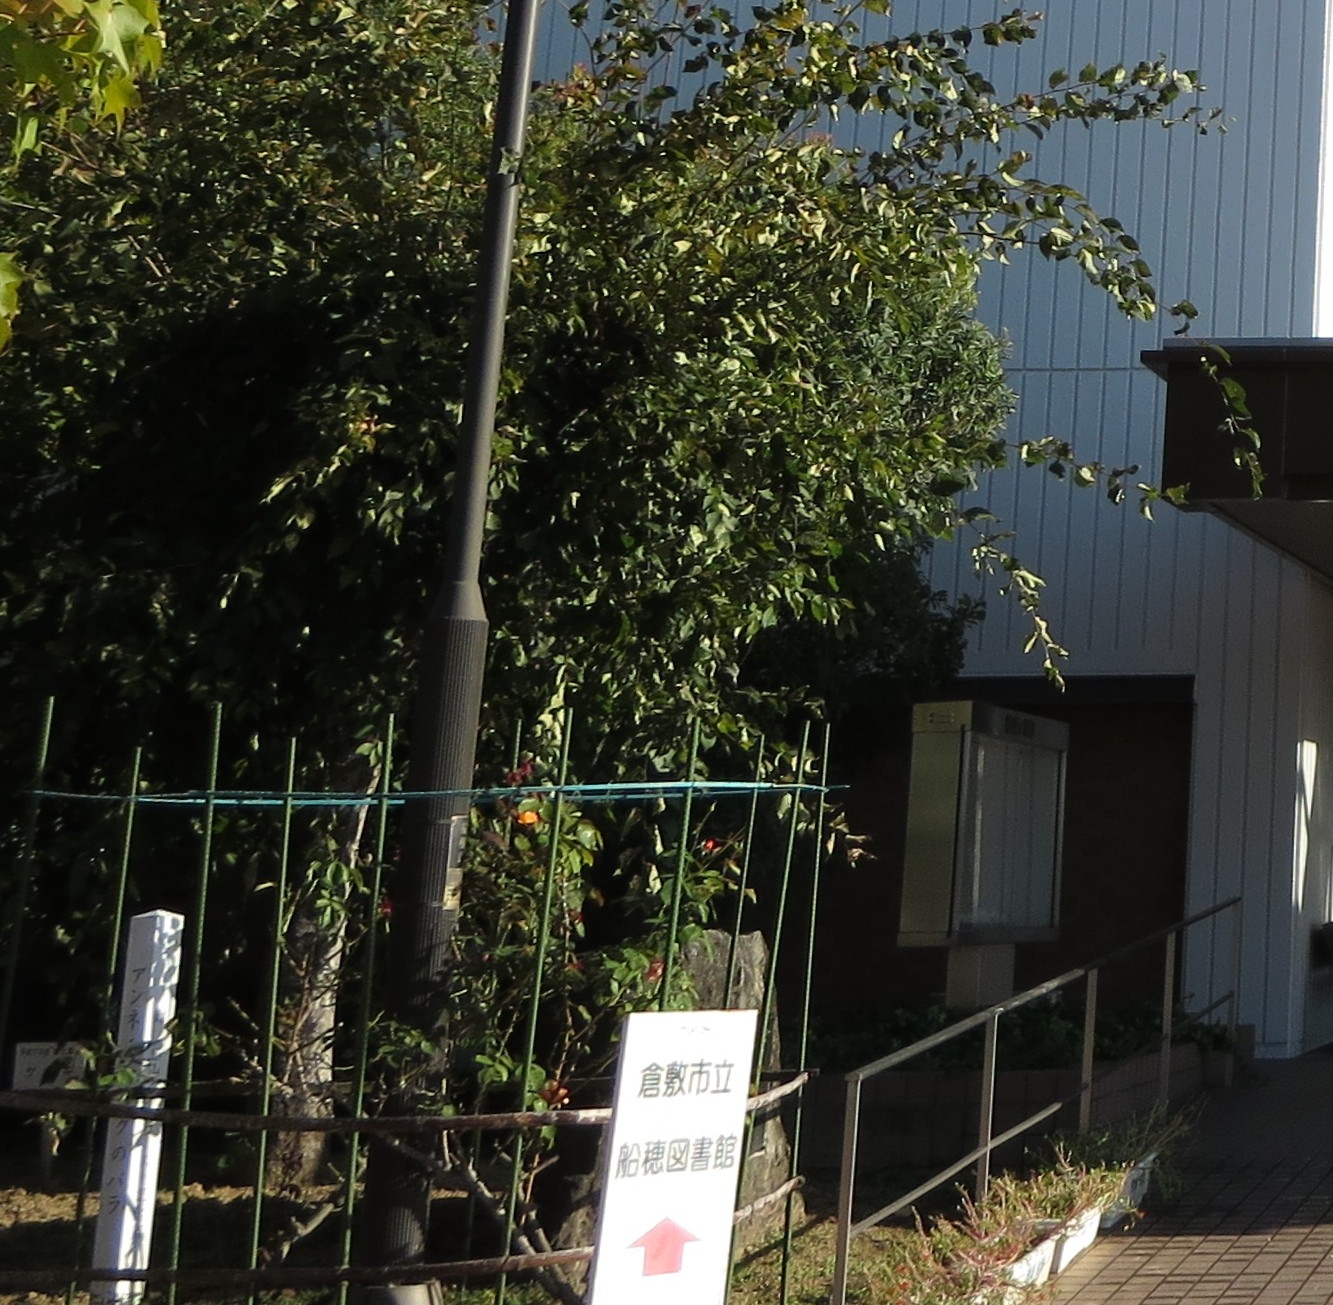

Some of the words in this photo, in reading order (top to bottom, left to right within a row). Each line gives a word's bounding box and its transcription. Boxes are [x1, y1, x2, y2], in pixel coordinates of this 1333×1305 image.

[639, 1059, 734, 1098] 倉敷市立
[615, 1134, 737, 1179] 船穂図書館
